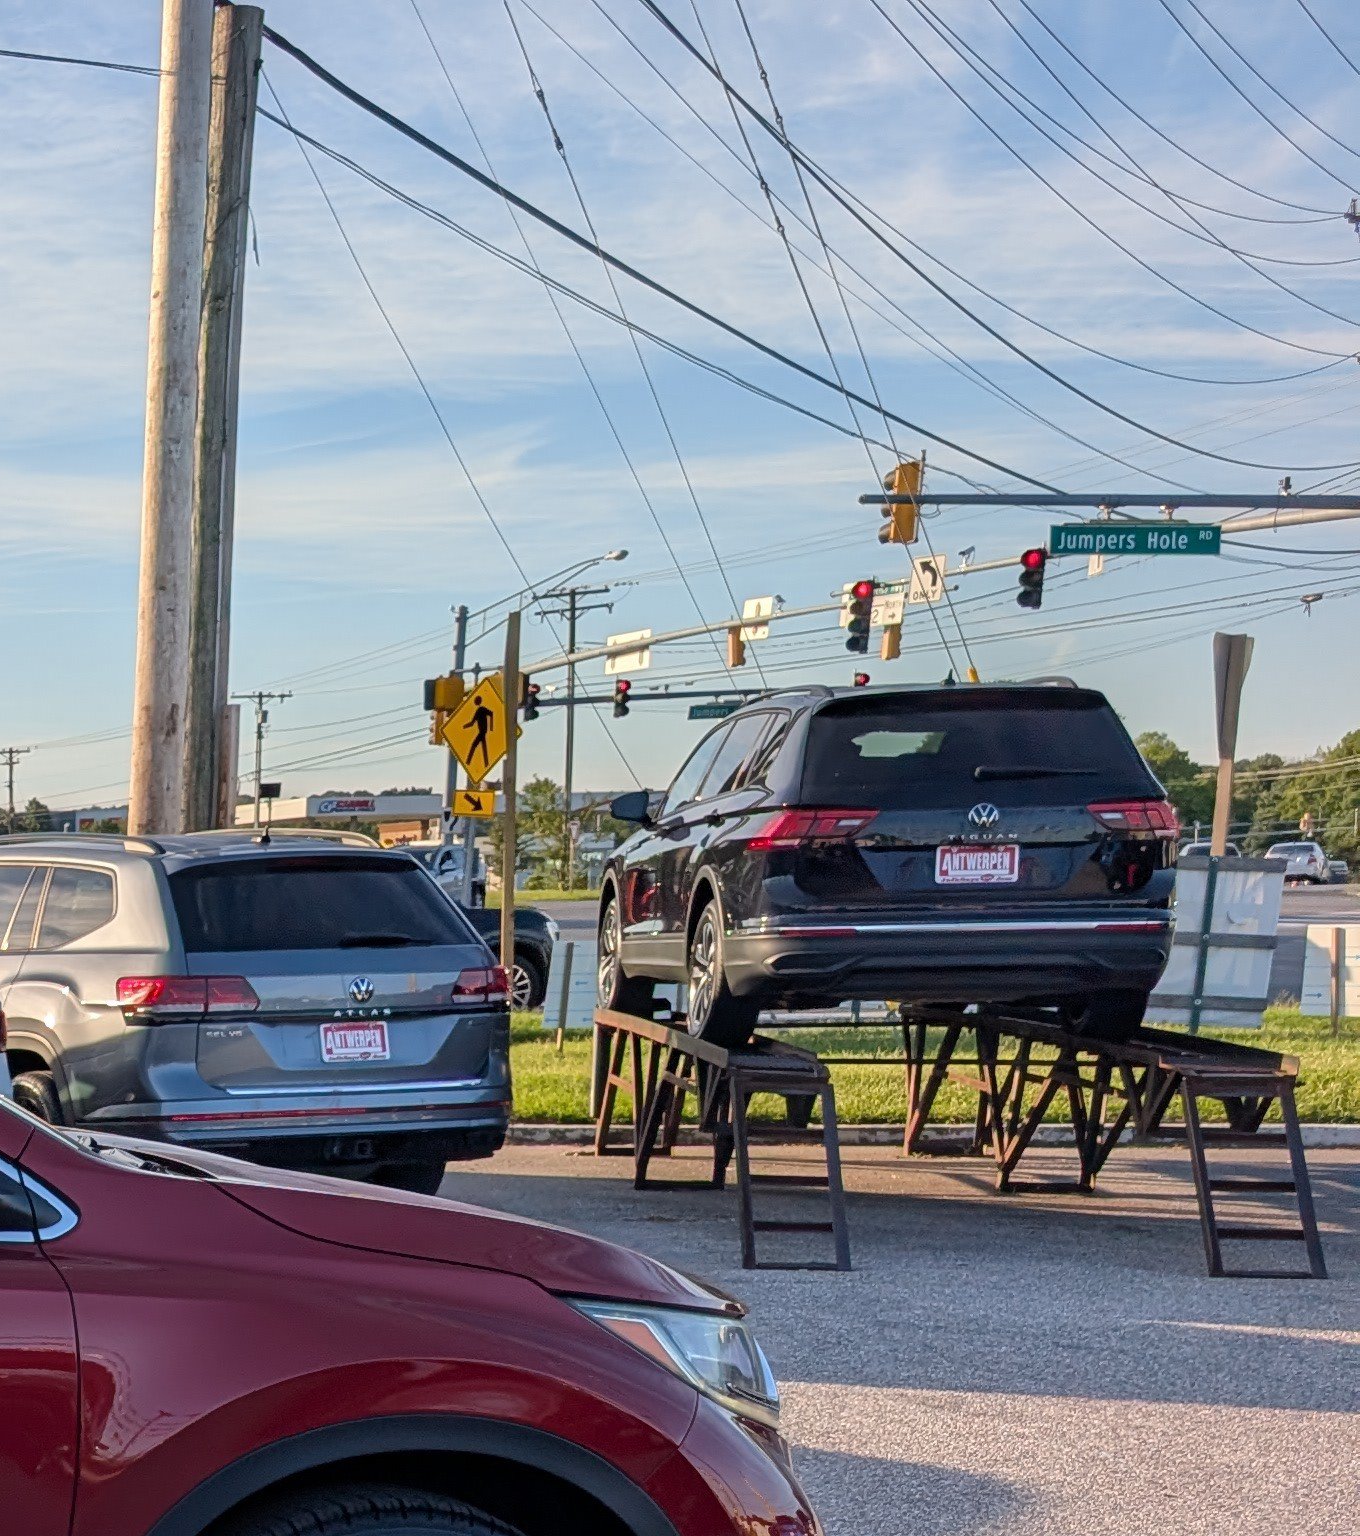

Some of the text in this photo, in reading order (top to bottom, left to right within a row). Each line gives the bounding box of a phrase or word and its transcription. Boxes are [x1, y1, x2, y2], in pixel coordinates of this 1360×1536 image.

[1057, 530, 1214, 554] Jumpers Hole RD
[913, 588, 937, 601] ONLY
[947, 833, 1018, 841] TIGUAN
[941, 852, 1011, 871] ANTWERPEN
[333, 1008, 392, 1018] ATLAS
[326, 1029, 381, 1049] ANTWERPEN
